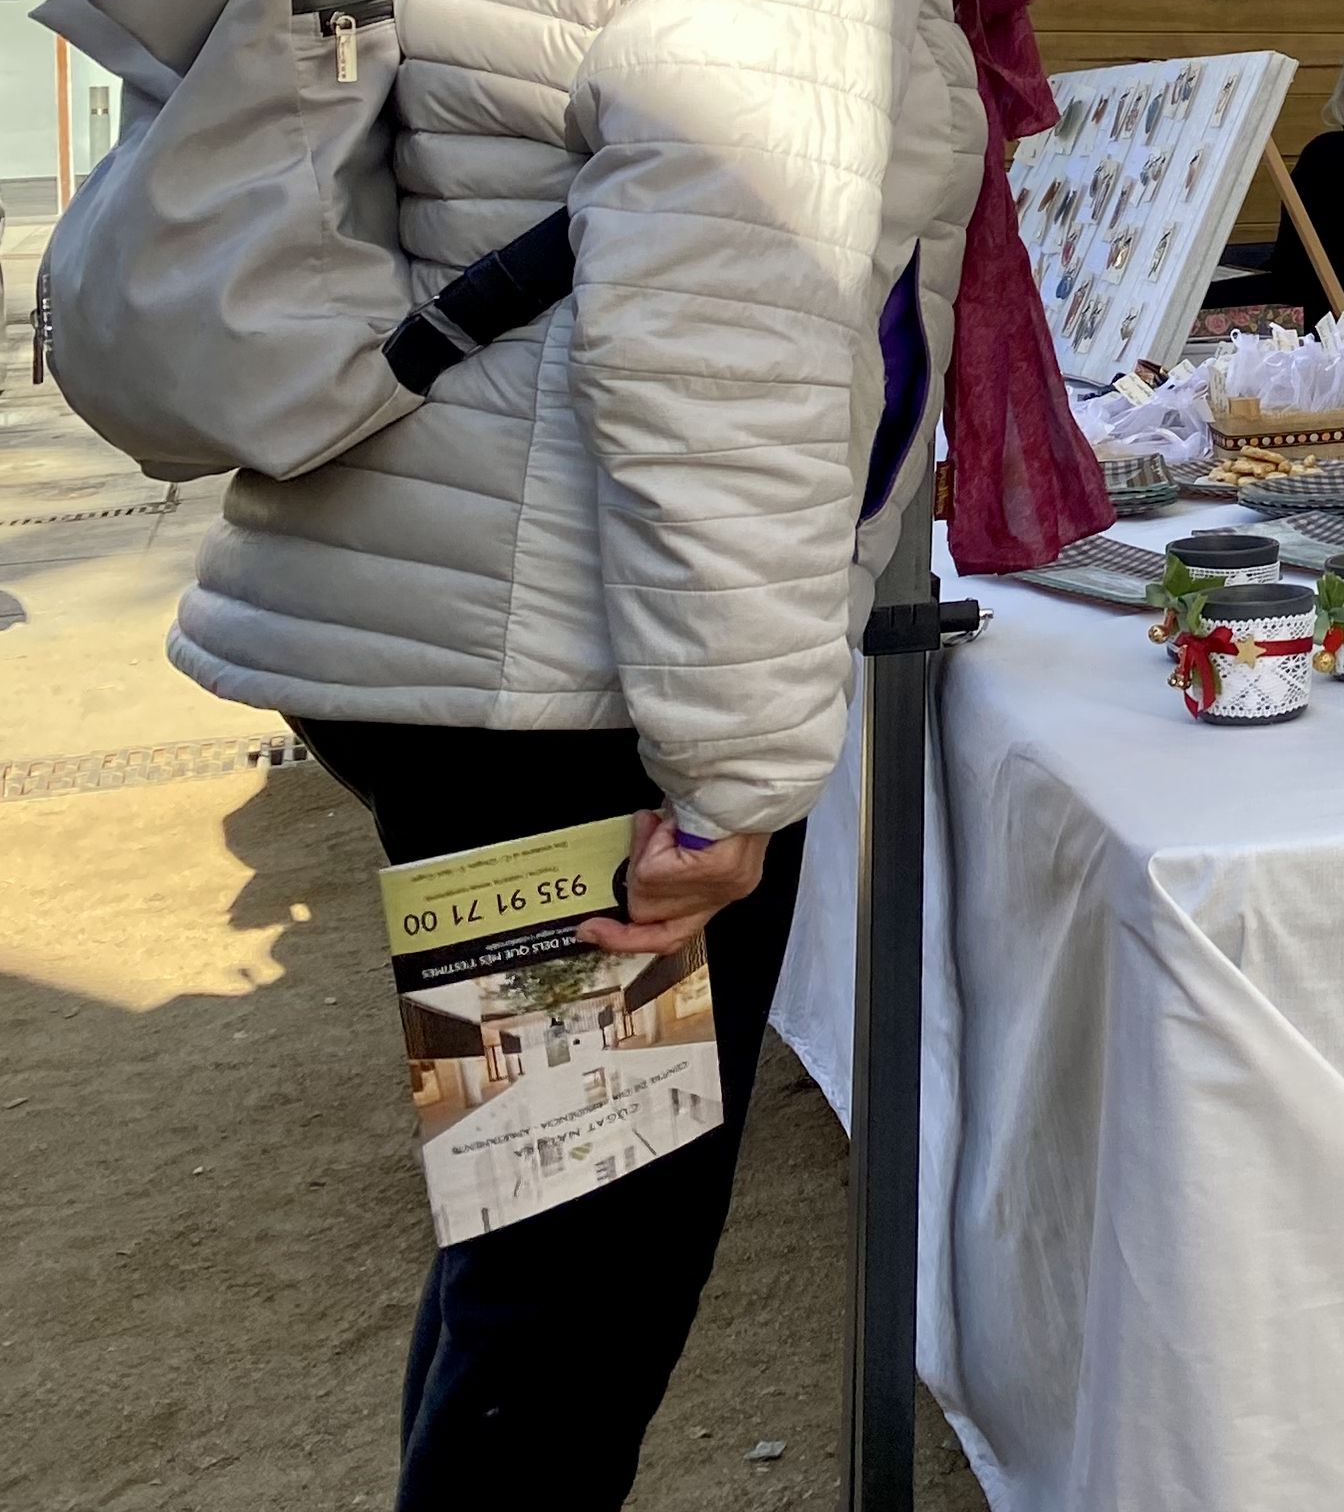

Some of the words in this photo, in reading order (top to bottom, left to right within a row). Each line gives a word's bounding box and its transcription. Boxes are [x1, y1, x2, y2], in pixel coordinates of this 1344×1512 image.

[537, 874, 587, 904] 935
[452, 900, 483, 926] 71
[496, 889, 527, 915] 91
[404, 911, 437, 936] 00
[505, 944, 530, 957] QUE
[532, 938, 560, 950] DELS
